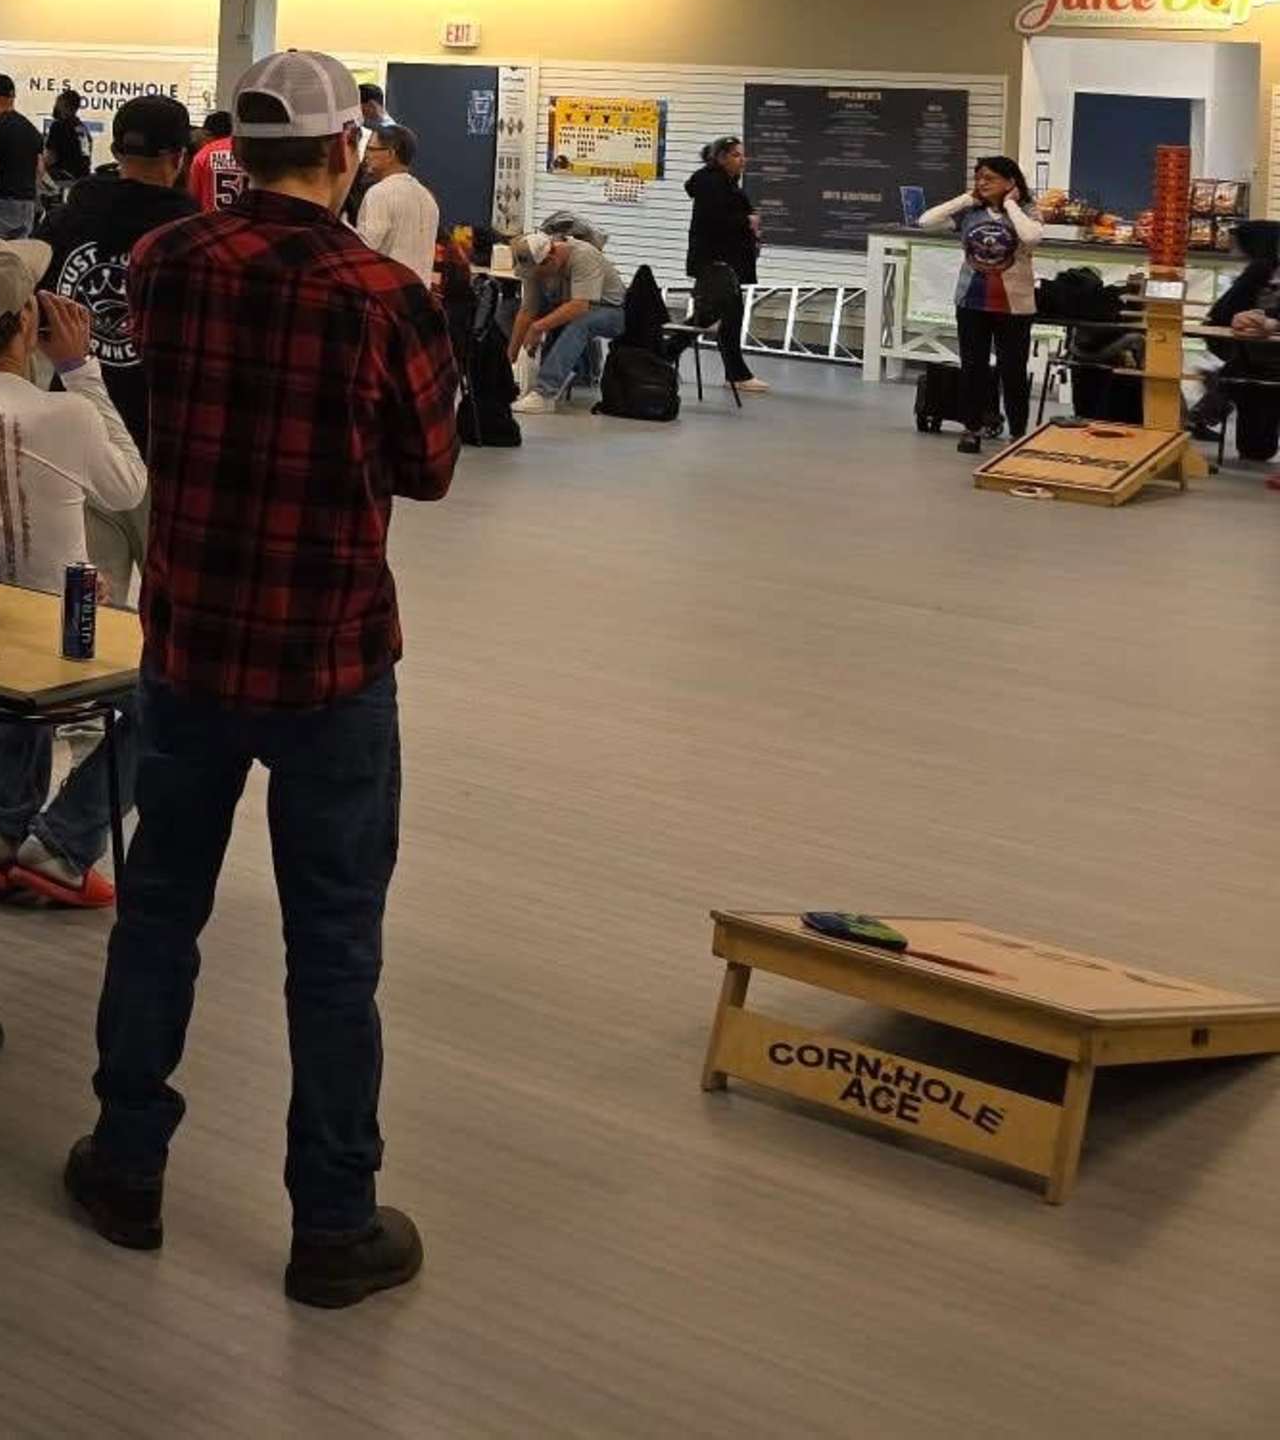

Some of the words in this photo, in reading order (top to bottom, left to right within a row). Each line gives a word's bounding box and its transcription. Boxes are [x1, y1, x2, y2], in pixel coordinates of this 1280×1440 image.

[446, 23, 471, 43] EXIT
[82, 80, 179, 99] CORNHOLE
[79, 95, 130, 112] OUNG
[81, 592, 94, 644] ULTRA
[840, 1077, 923, 1125] ACE
